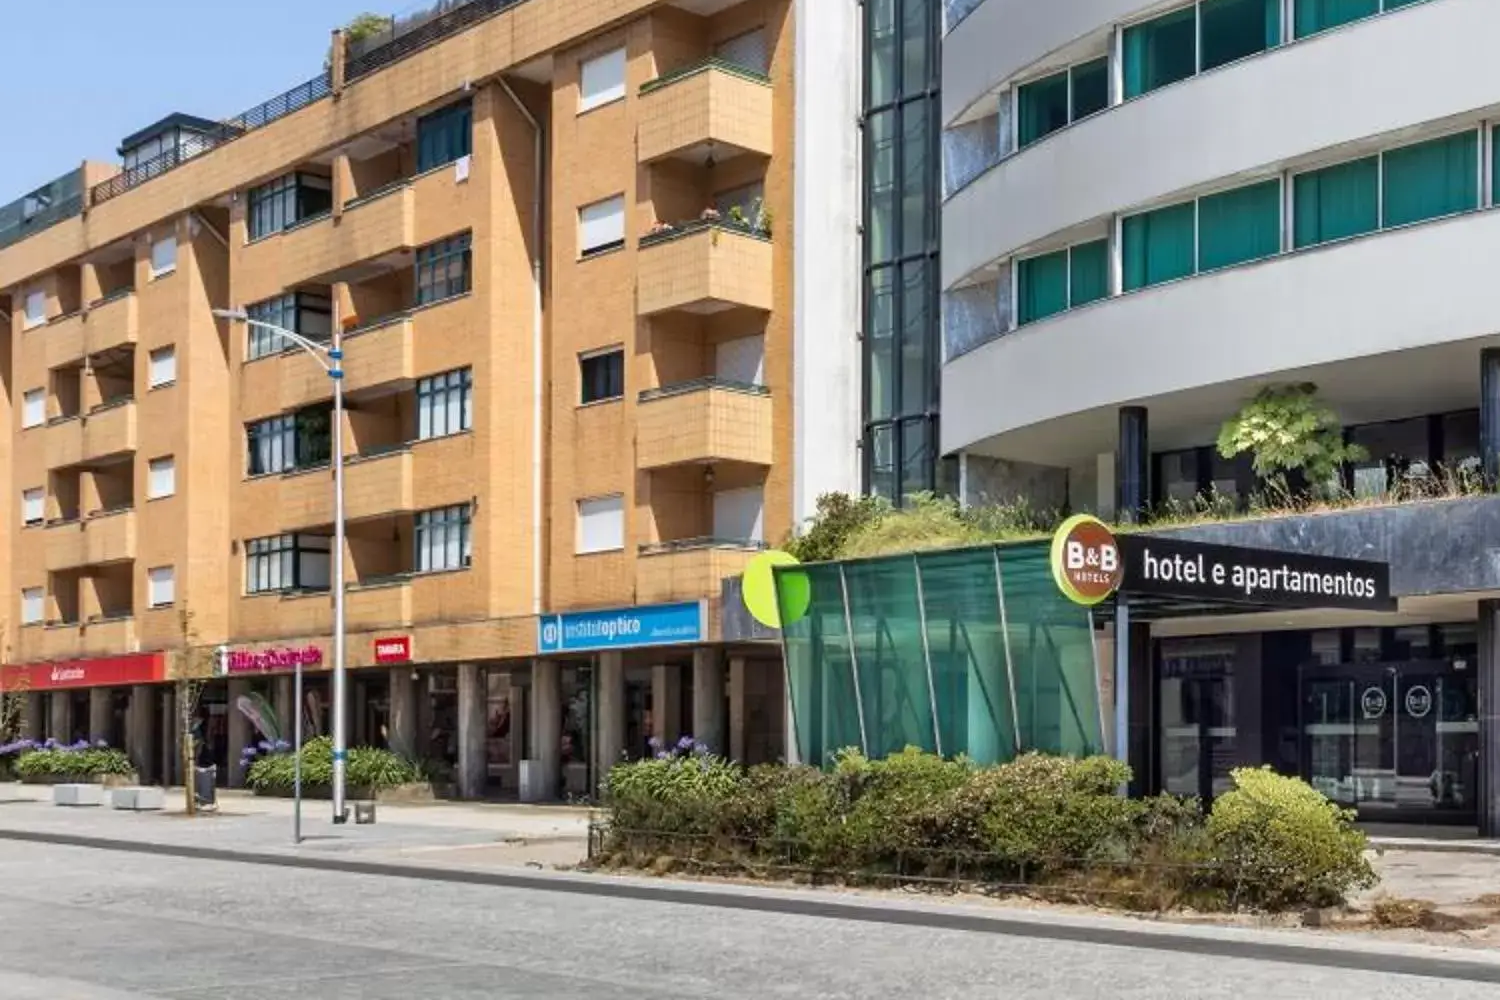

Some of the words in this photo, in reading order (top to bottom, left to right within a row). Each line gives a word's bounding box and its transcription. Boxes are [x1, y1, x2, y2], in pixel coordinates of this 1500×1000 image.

[1067, 541, 1118, 572] B&B
[1073, 571, 1111, 584] HOTELS
[1143, 549, 1205, 584] hotel
[1212, 564, 1226, 585] e
[1232, 564, 1376, 598] apartamentos
